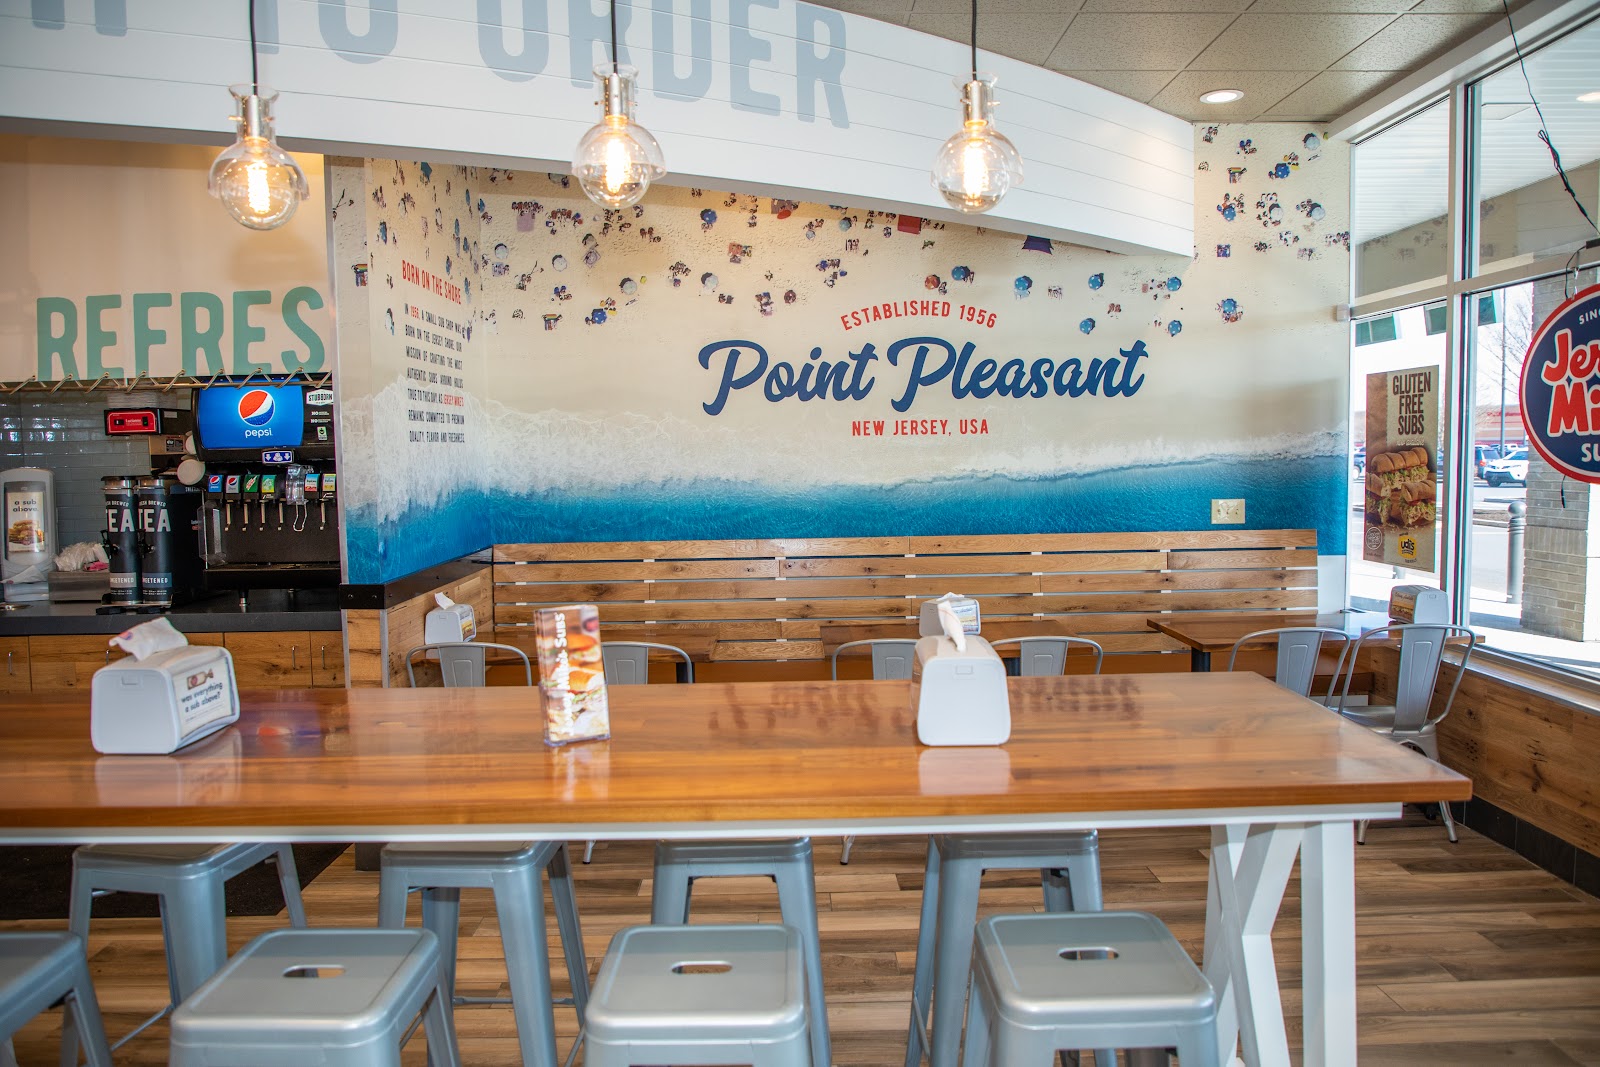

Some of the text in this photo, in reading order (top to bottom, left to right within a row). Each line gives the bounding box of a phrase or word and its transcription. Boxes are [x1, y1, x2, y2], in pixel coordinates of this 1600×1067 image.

[477, 0, 850, 130] ORDER
[402, 259, 462, 305] BORN ON THE SHORE
[421, 309, 425, 321] A
[840, 300, 997, 332] ESTABLISHED 1956
[1578, 308, 1600, 325] SIN
[36, 286, 325, 382] REFRES
[405, 324, 415, 338] BORN
[405, 345, 421, 360] MISSION
[407, 367, 426, 381] AUTHENTIC
[698, 336, 1149, 417] Point Pleasant
[1392, 371, 1431, 396] GLUTEN
[407, 388, 417, 400] TRUE
[422, 390, 430, 402] THIS
[1399, 393, 1424, 415] FREE
[408, 409, 424, 422] REMAINS
[244, 427, 272, 439] pepsi
[852, 419, 989, 437] NEW JERSEY, USA
[1397, 414, 1425, 436] SUBS
[426, 431, 439, 443] FLAVOR
[106, 508, 135, 532] EA
[181, 682, 223, 703] was everything
[190, 700, 200, 711] sub
